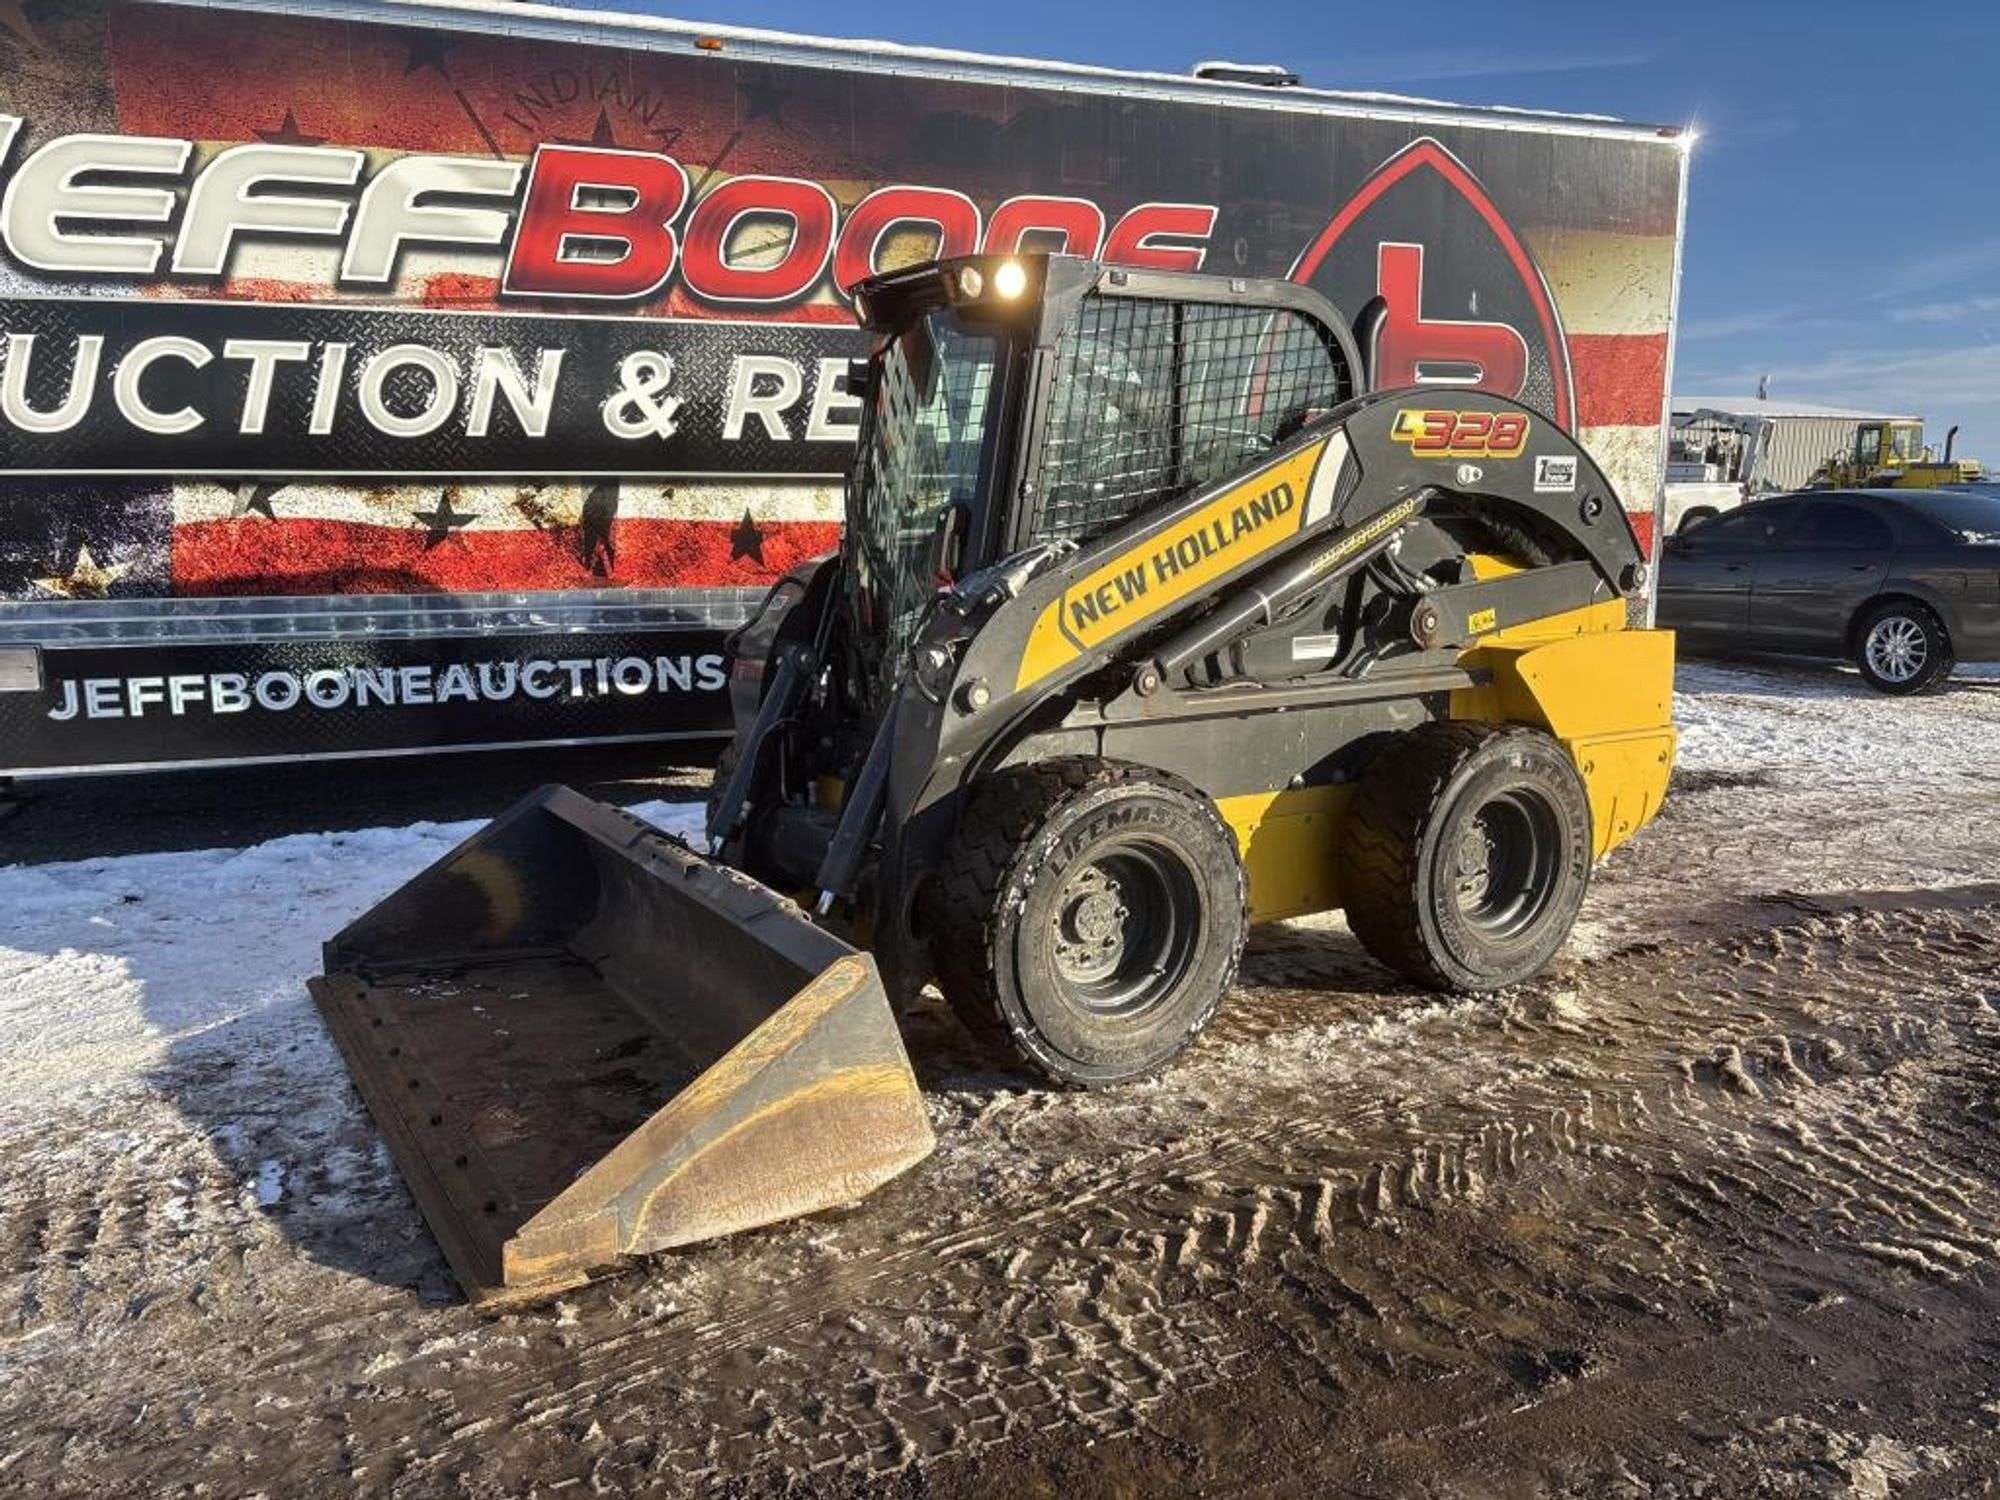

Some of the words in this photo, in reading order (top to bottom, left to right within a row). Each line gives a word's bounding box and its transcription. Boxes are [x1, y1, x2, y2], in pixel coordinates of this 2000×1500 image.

[0, 115, 1218, 300] EFFBOONE
[602, 350, 680, 440] &
[1391, 409, 1530, 457] L328
[1070, 562, 1149, 630] NEW
[1152, 481, 1295, 585] HOLLAND
